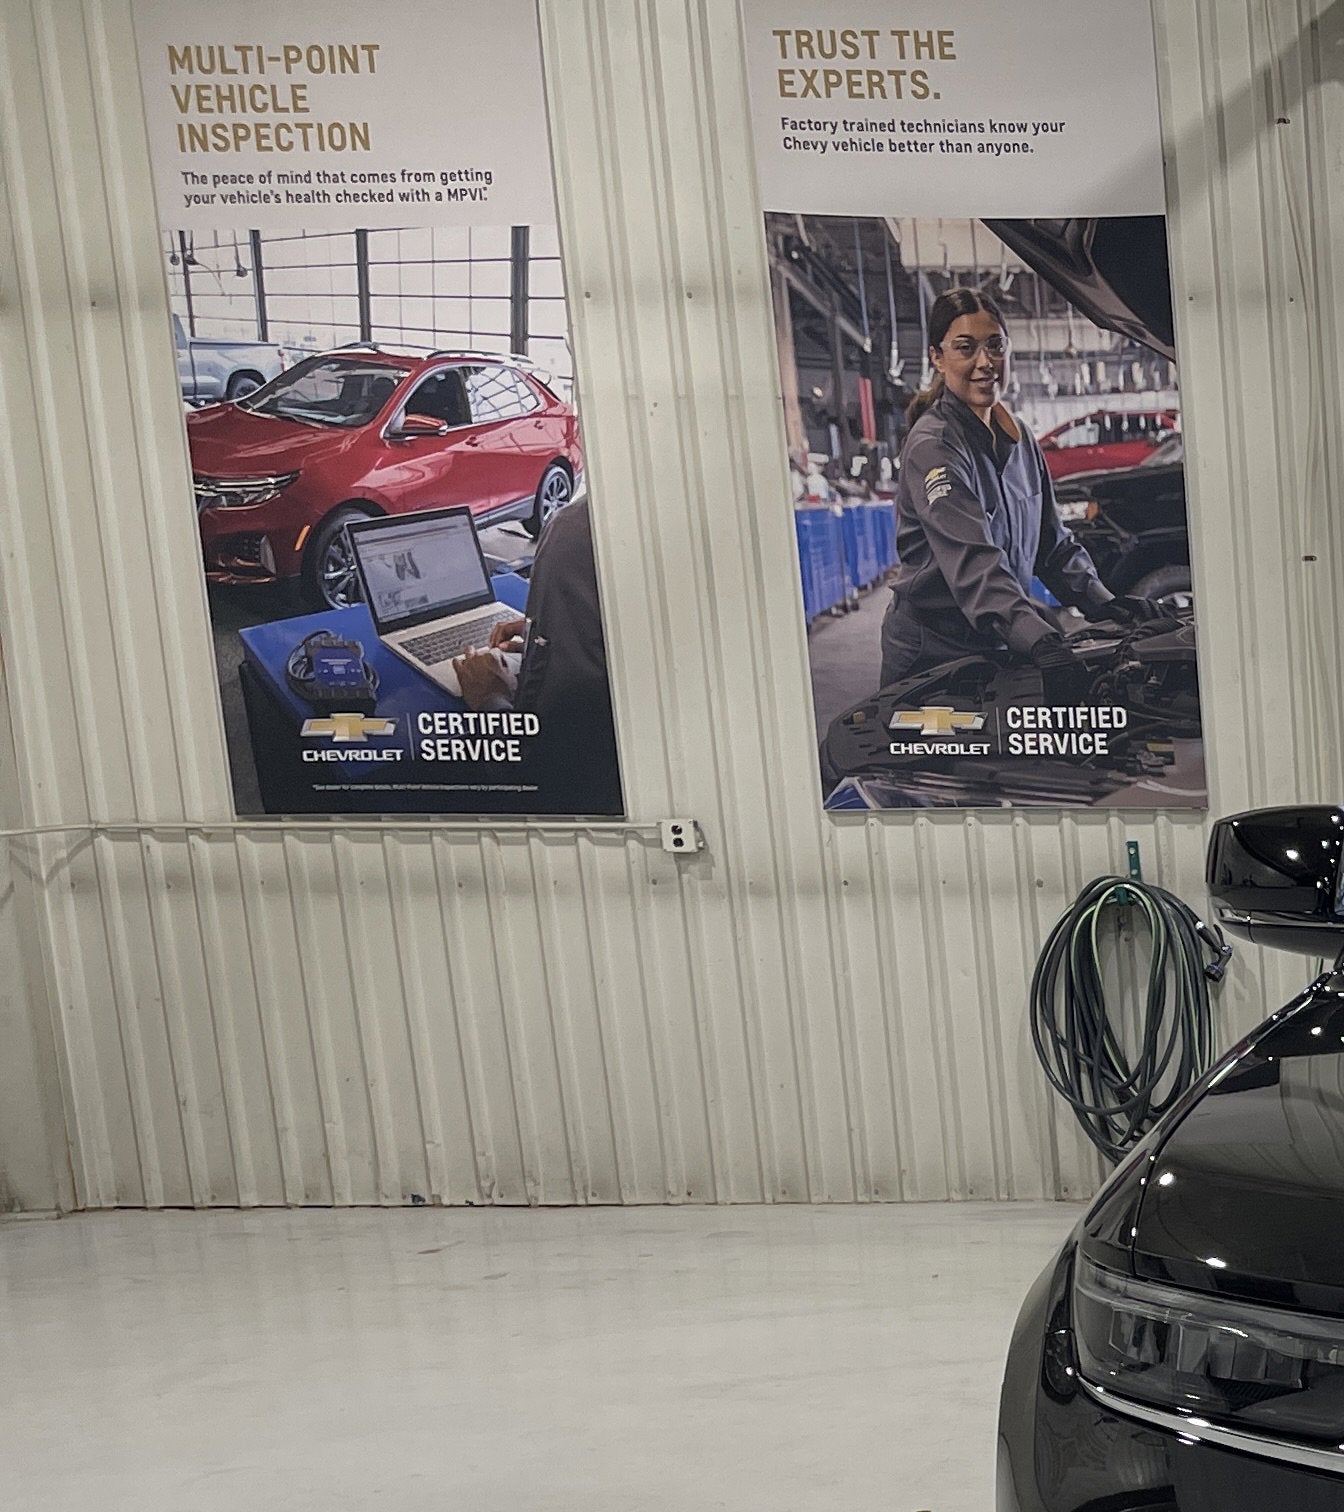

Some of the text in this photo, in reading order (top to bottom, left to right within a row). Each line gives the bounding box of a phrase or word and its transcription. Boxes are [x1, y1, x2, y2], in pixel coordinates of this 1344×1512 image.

[772, 29, 957, 60] TRUST THE
[168, 44, 380, 75] MULTI-POINT
[778, 69, 941, 100] EXPERTS.
[171, 84, 310, 114] VEHICLE
[176, 122, 371, 153] INSPECTION
[781, 117, 1066, 136] Factory trained technicians know your
[783, 137, 1034, 156] Chevy vehicle better than anyone.
[181, 168, 493, 188] The peace of mind that comes from getting
[184, 191, 216, 208] your
[220, 189, 281, 204] vehicle's
[286, 188, 330, 203] health
[335, 188, 394, 203] checked
[399, 188, 430, 202] with
[435, 191, 443, 202] a
[417, 712, 541, 736] CERTIFIED
[1006, 706, 1128, 729] CERTIFIED
[420, 739, 522, 761] SERVICE
[889, 742, 991, 755] CHEVROLET
[1008, 733, 1109, 755] SERVICE
[302, 749, 404, 762] CHEVROLET
